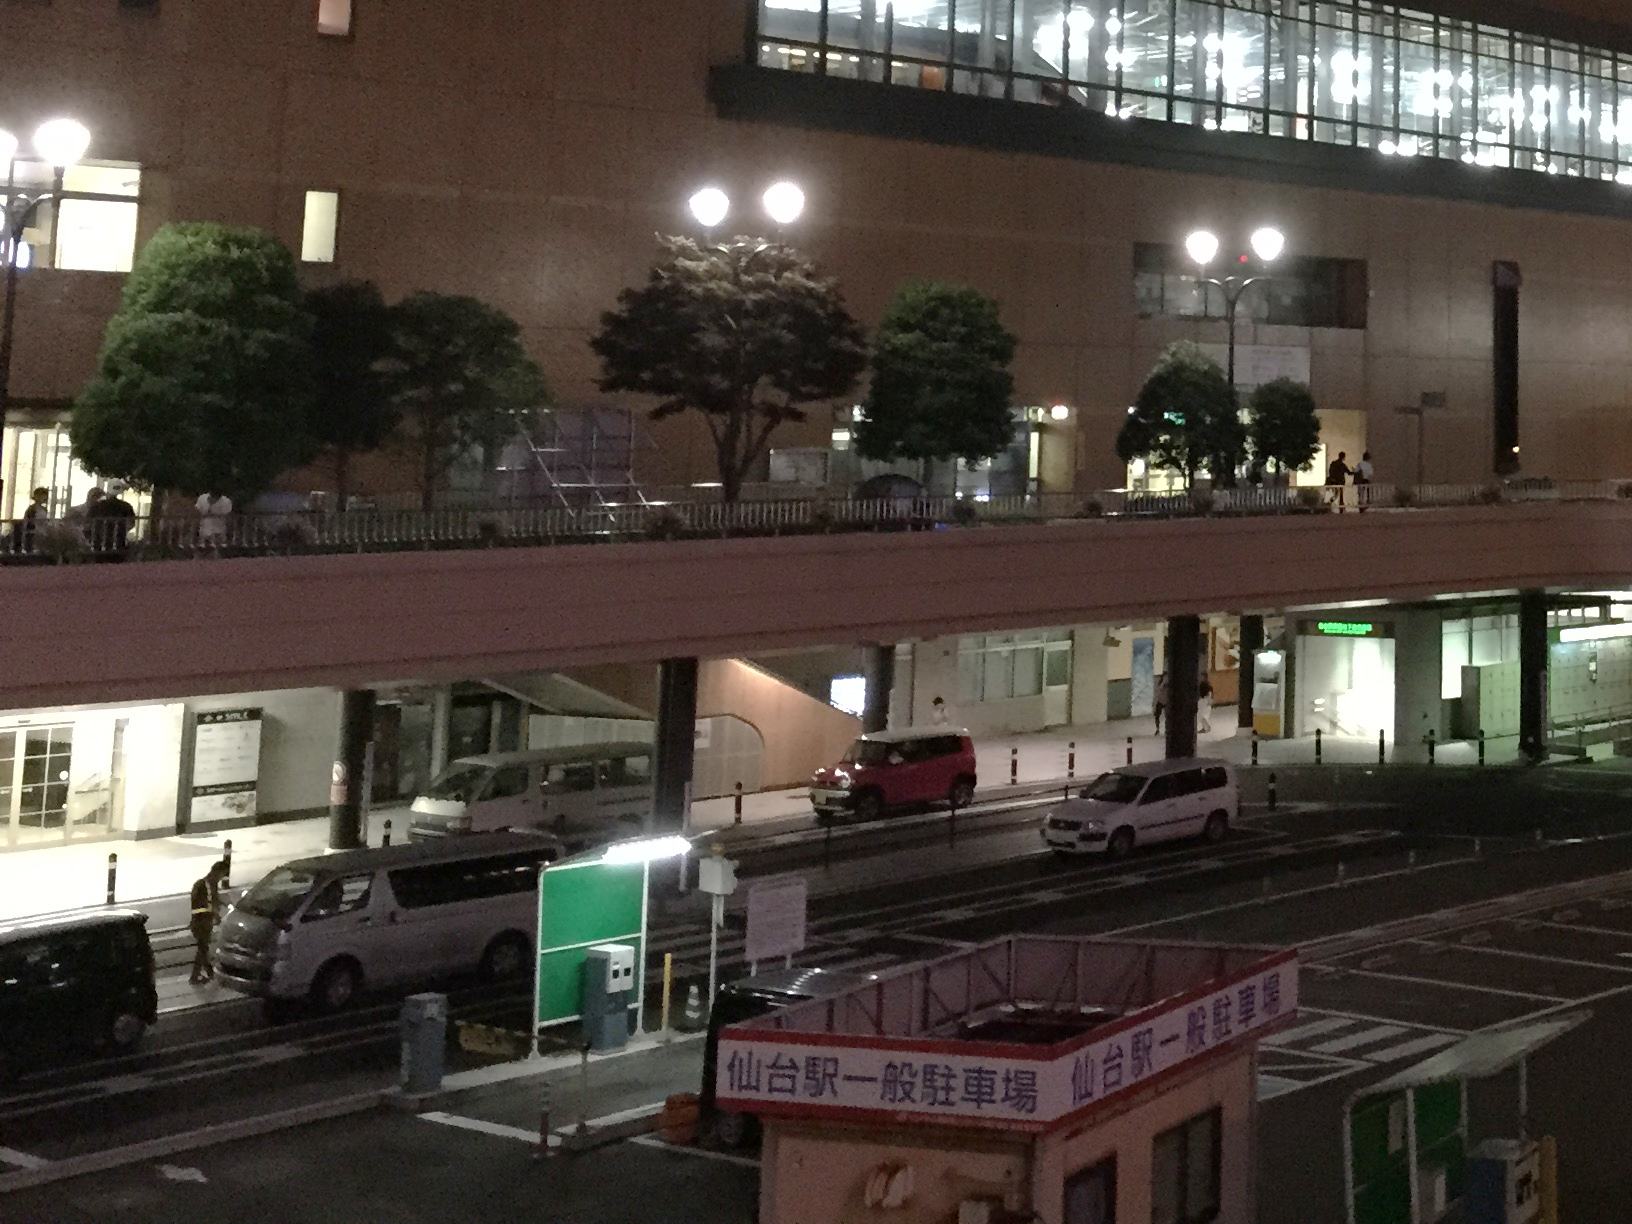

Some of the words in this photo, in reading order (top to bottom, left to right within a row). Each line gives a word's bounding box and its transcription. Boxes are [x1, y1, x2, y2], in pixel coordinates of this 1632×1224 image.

[726, 1049, 1039, 1114] 仙台駅一般駐車場
[1071, 971, 1281, 1106] 仙台駅一般駐車場
